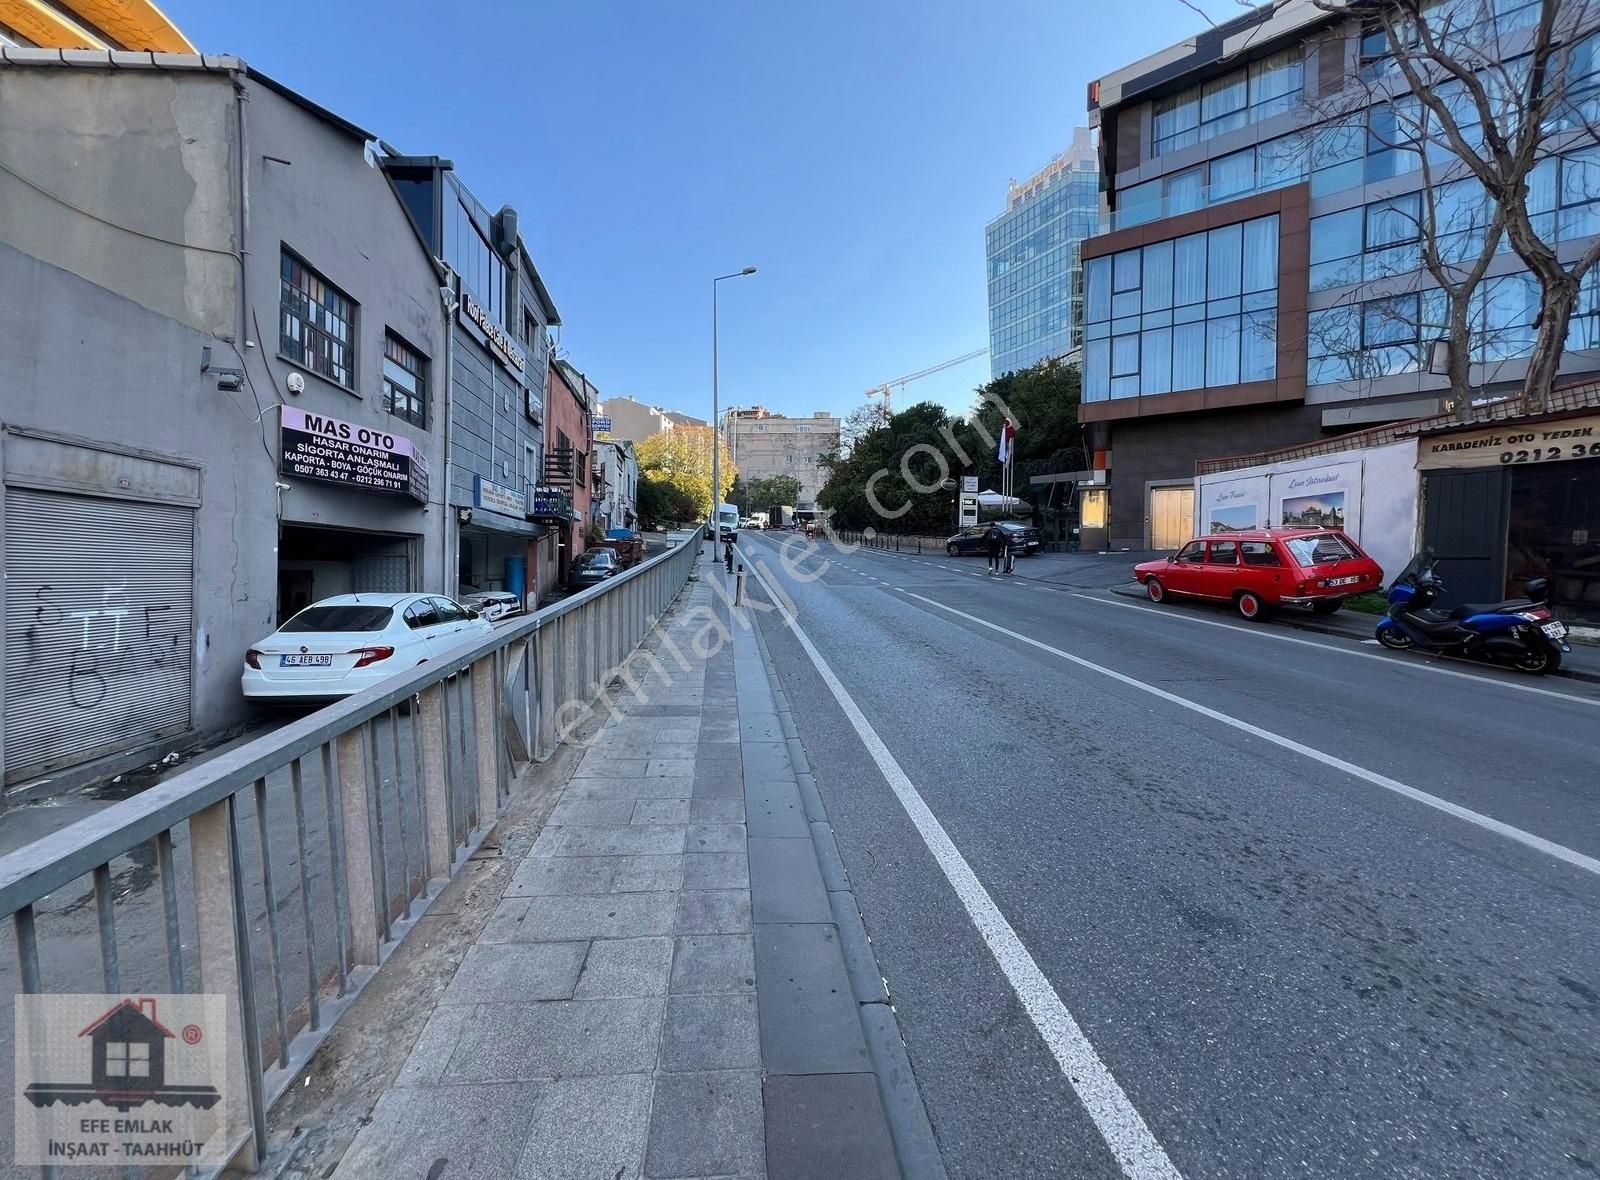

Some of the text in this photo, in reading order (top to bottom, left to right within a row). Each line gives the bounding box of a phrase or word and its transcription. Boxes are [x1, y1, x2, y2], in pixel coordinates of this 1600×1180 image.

[304, 413, 395, 450] MAS OTO
[1431, 427, 1593, 453] KARADENİZ OTO YEDEK
[296, 442, 345, 460] SİGORTA
[346, 454, 400, 471] ANLAŞMALI
[312, 436, 389, 460] HASAR ONARIM
[1500, 446, 1561, 464] 0212
[284, 451, 326, 467] KAPORTA
[331, 460, 352, 471] BOYA
[356, 465, 382, 477] GÖÇÜK
[383, 470, 408, 481] ONARIM
[294, 464, 313, 475] 0507
[330, 469, 339, 479] 43
[340, 472, 348, 480] 47
[356, 475, 372, 484] 0212
[385, 478, 392, 487] 71
[393, 480, 401, 489] 91
[299, 655, 313, 664] AEB
